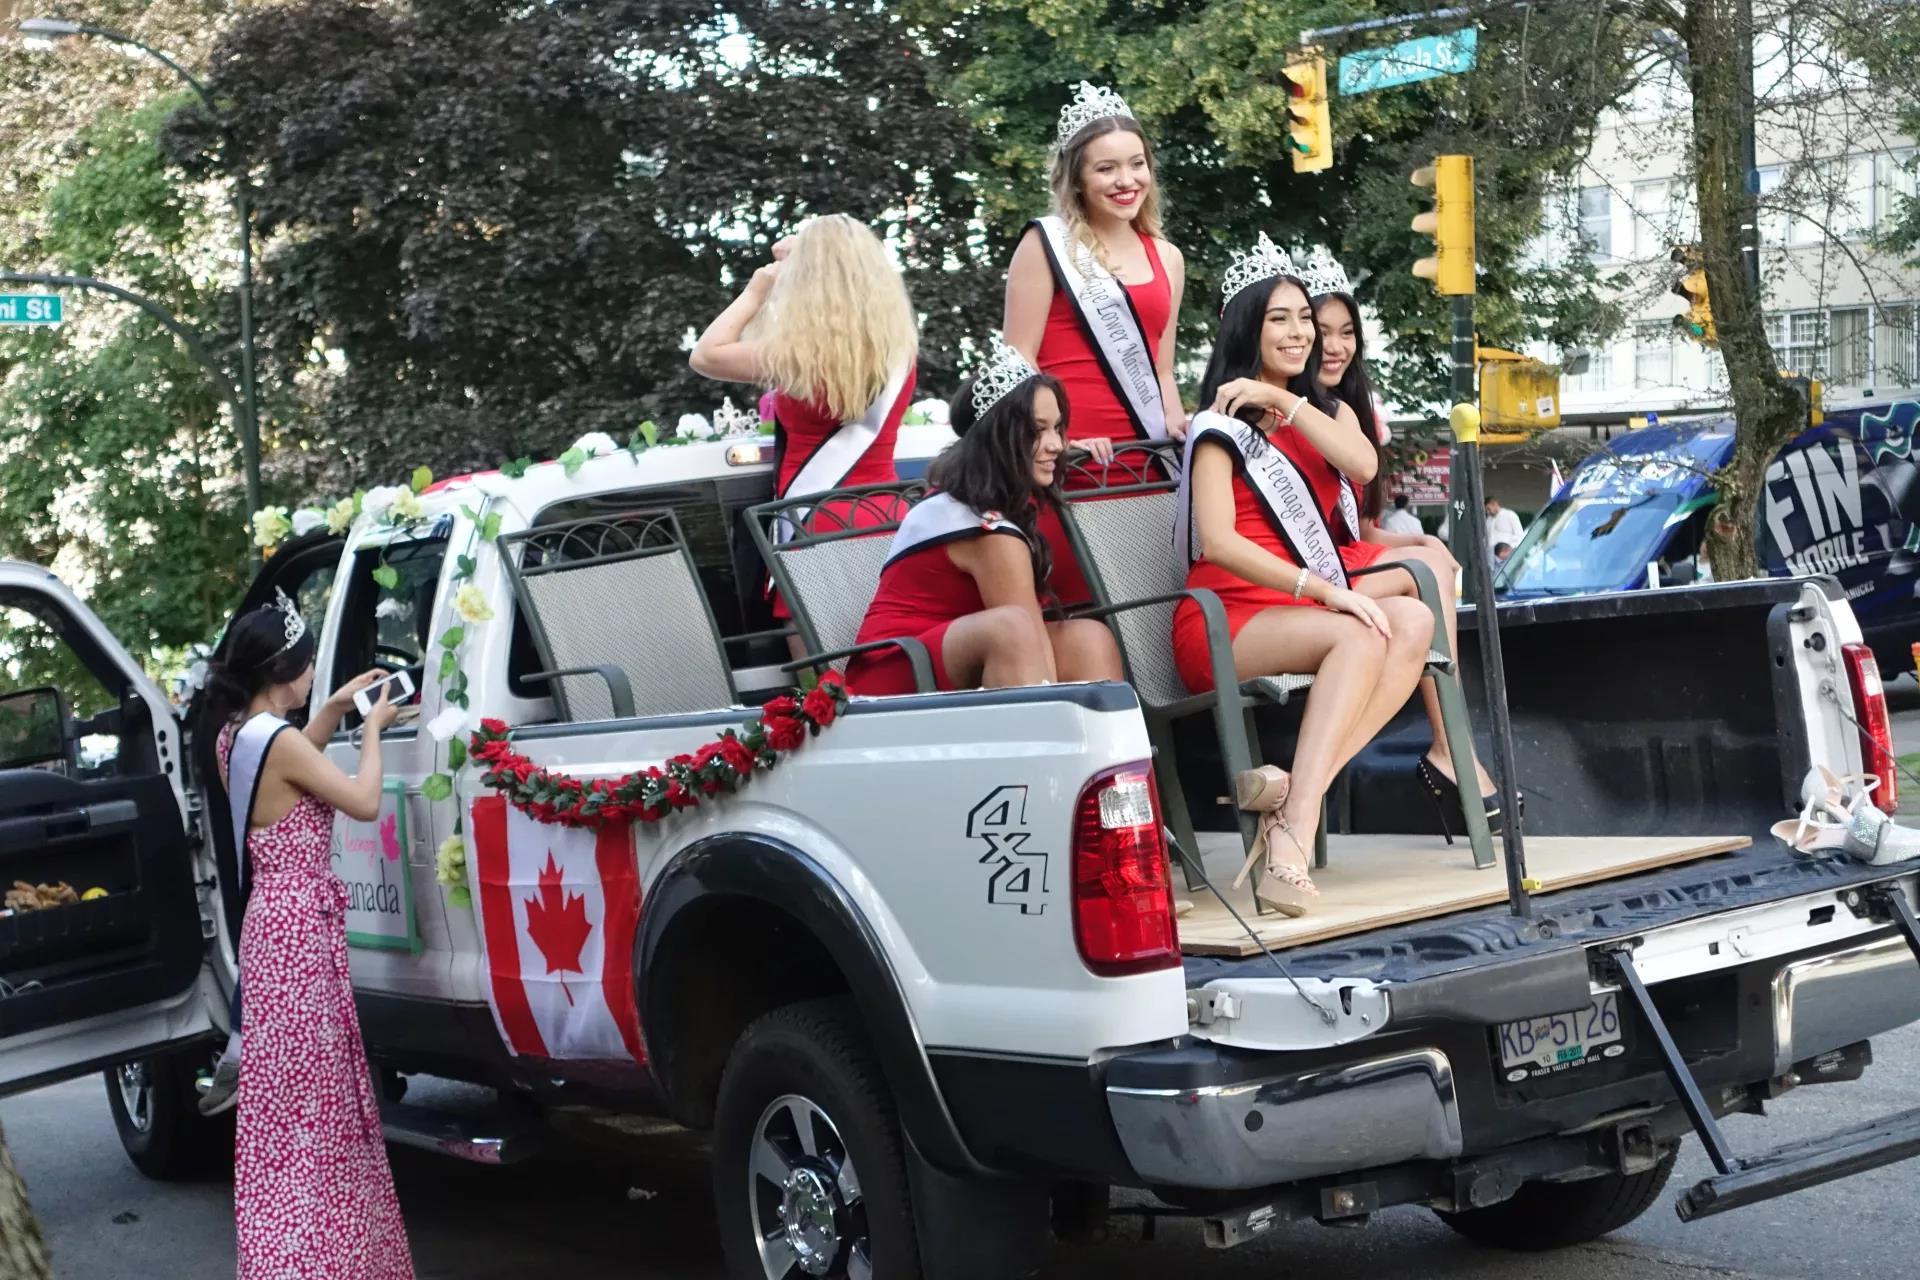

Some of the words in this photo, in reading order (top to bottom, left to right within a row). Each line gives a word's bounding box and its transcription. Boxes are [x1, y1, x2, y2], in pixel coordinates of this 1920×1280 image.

[27, 298, 52, 320] St
[1096, 302, 1129, 343] Lower
[1117, 341, 1159, 407] Mainland
[1262, 456, 1306, 524] Teenage
[1298, 520, 1334, 573] Maple
[1766, 437, 1864, 559] FIN
[1785, 531, 1870, 576] MOBILE
[1844, 580, 1875, 601] ANUCKS
[1500, 1020, 1536, 1060] KB
[1532, 1067, 1551, 1078] FRASER
[1553, 1063, 1571, 1073] VALLEY
[1572, 1059, 1586, 1068] AUTO
[1587, 1054, 1601, 1063] MALL
